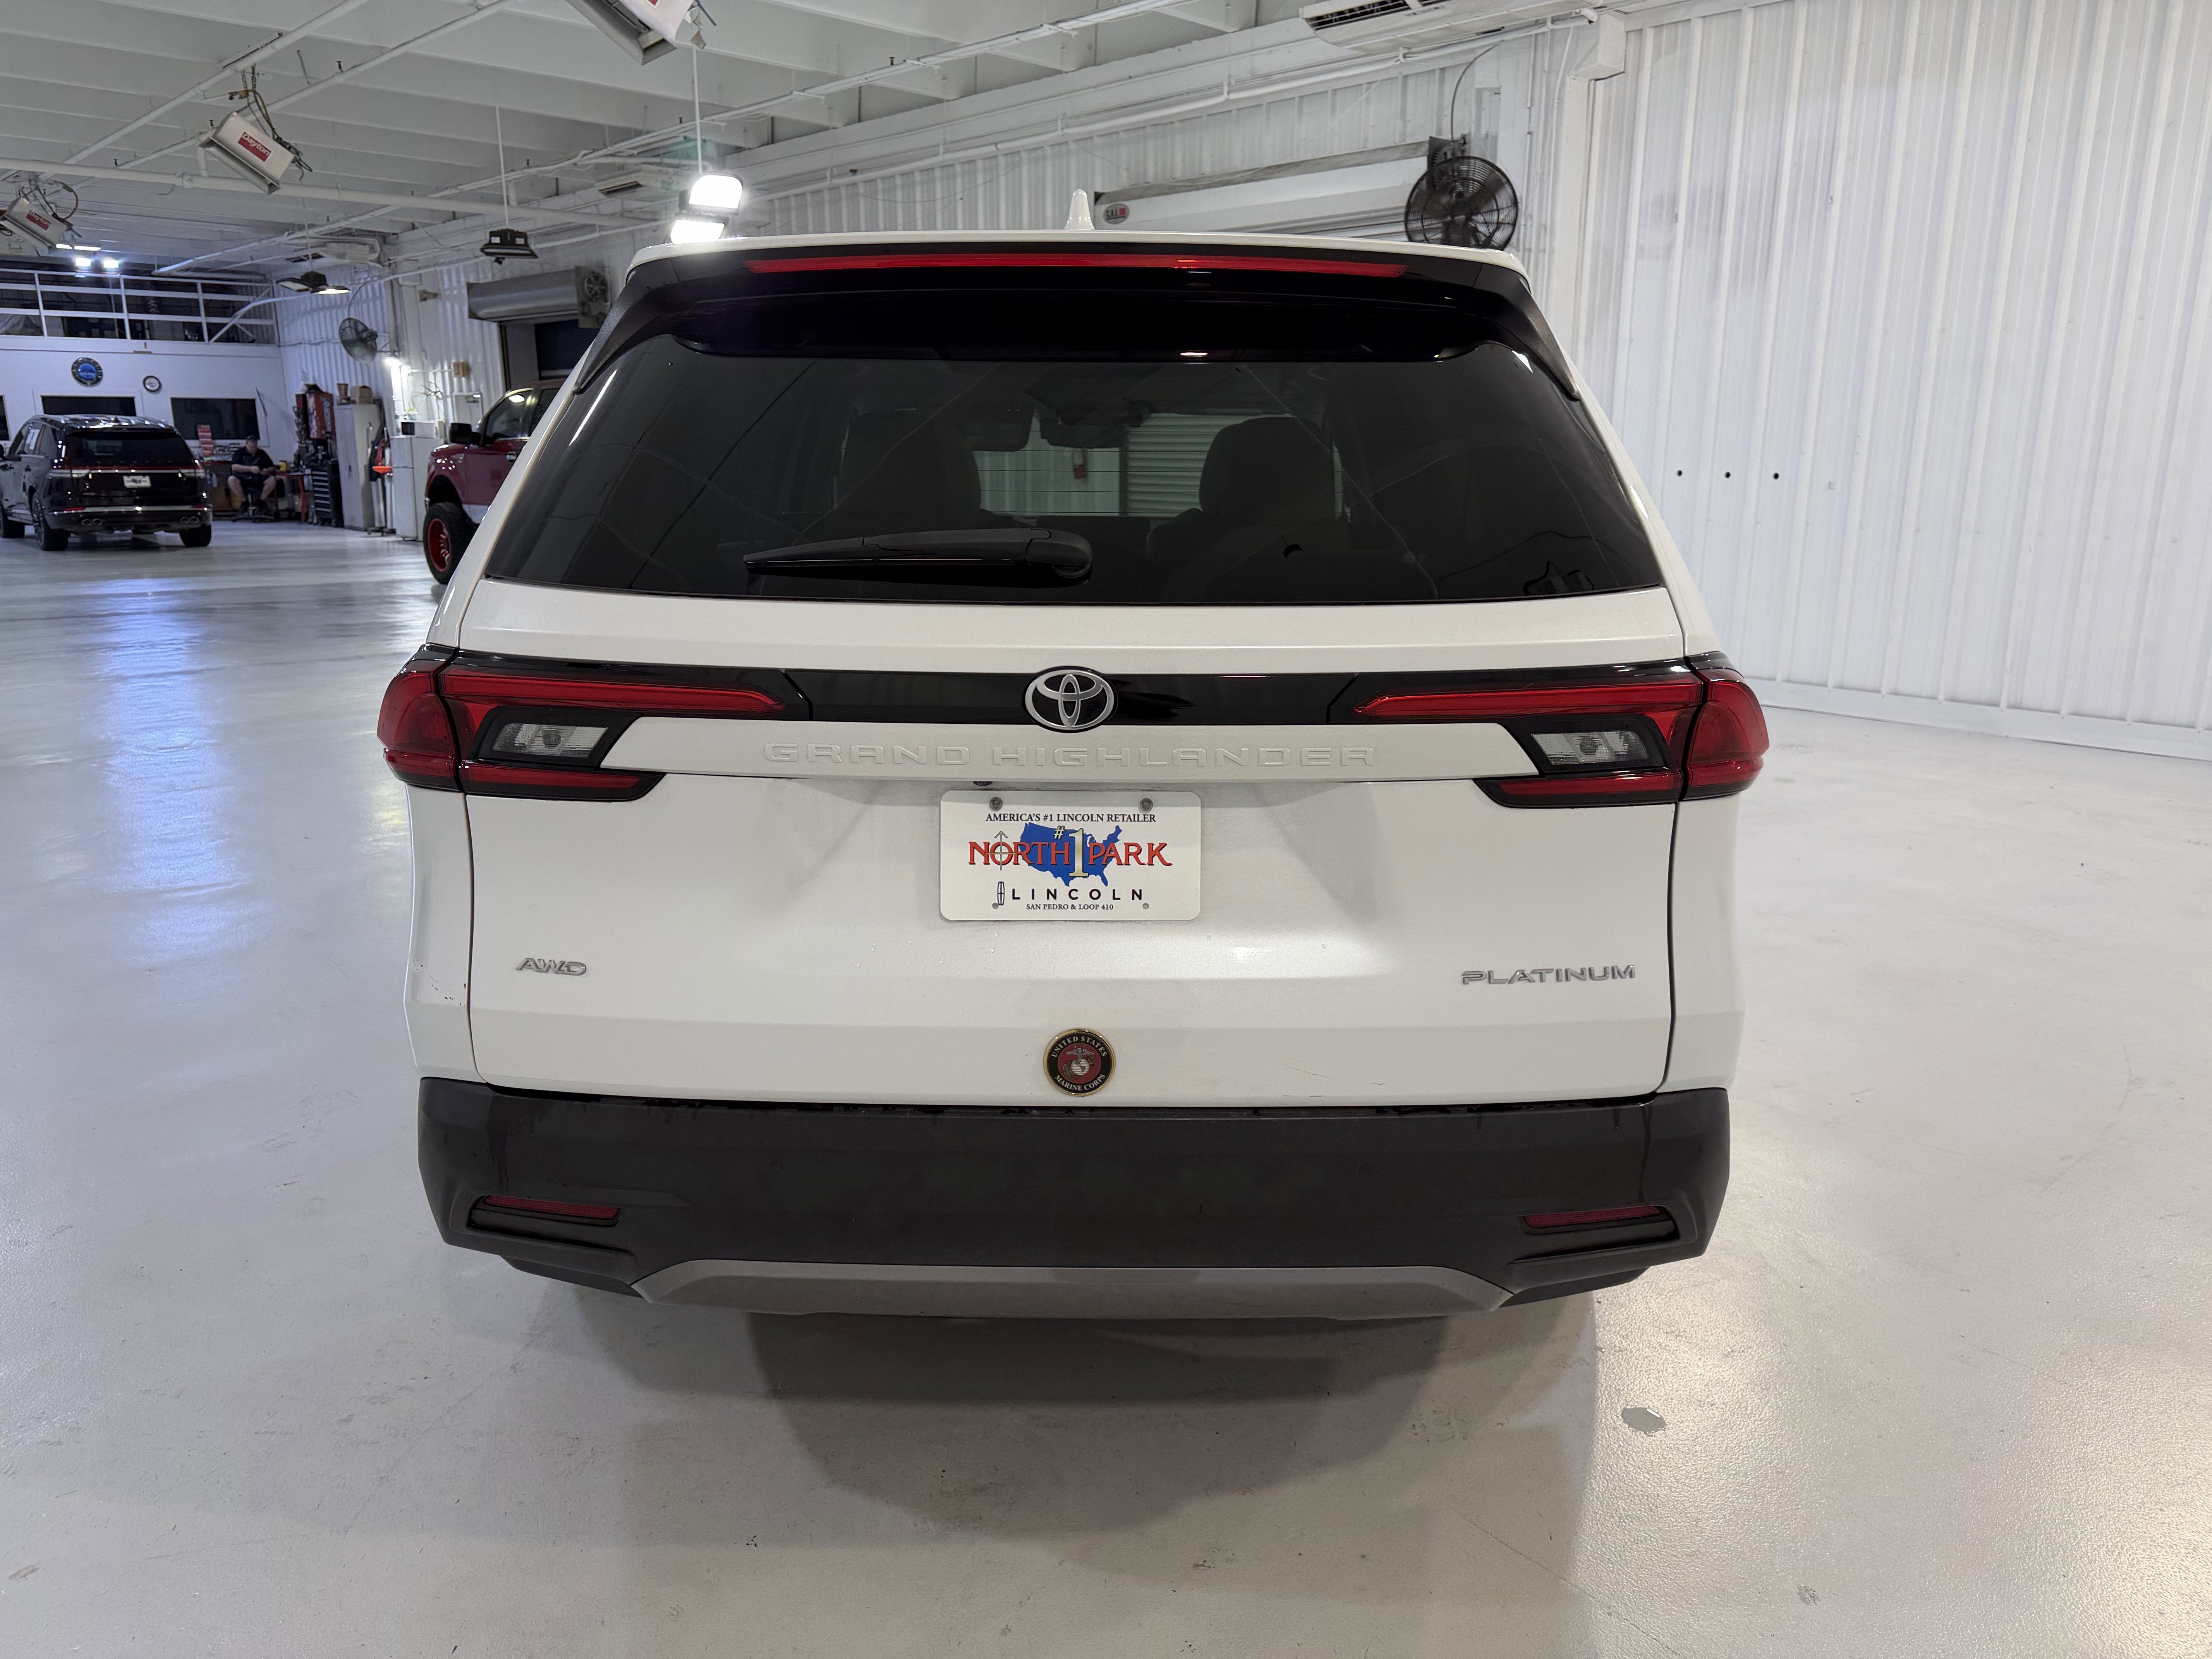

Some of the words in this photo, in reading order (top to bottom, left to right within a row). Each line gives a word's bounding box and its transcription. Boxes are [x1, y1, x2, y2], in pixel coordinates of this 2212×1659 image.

[242, 134, 270, 156] Dayton
[29, 211, 50, 226] Dayton
[764, 743, 969, 764] GRAND
[993, 747, 1374, 766] HIGHLANDER
[985, 813, 1041, 822] AMERICA'S
[1043, 814, 1053, 822] #1
[1056, 814, 1104, 822] LINCOLN
[1106, 814, 1156, 823] RETAILER
[968, 841, 1070, 866] NORTH
[1087, 842, 1173, 867] PARK
[1012, 888, 1142, 900] LINCOLN
[516, 957, 587, 975] AWD
[1462, 965, 1635, 985] PLATINUM
[1051, 1036, 1078, 1058] UNITED
[1080, 1036, 1108, 1057] STATES
[1054, 1075, 1083, 1091] MARINE
[1084, 1073, 1106, 1091] CORPS
